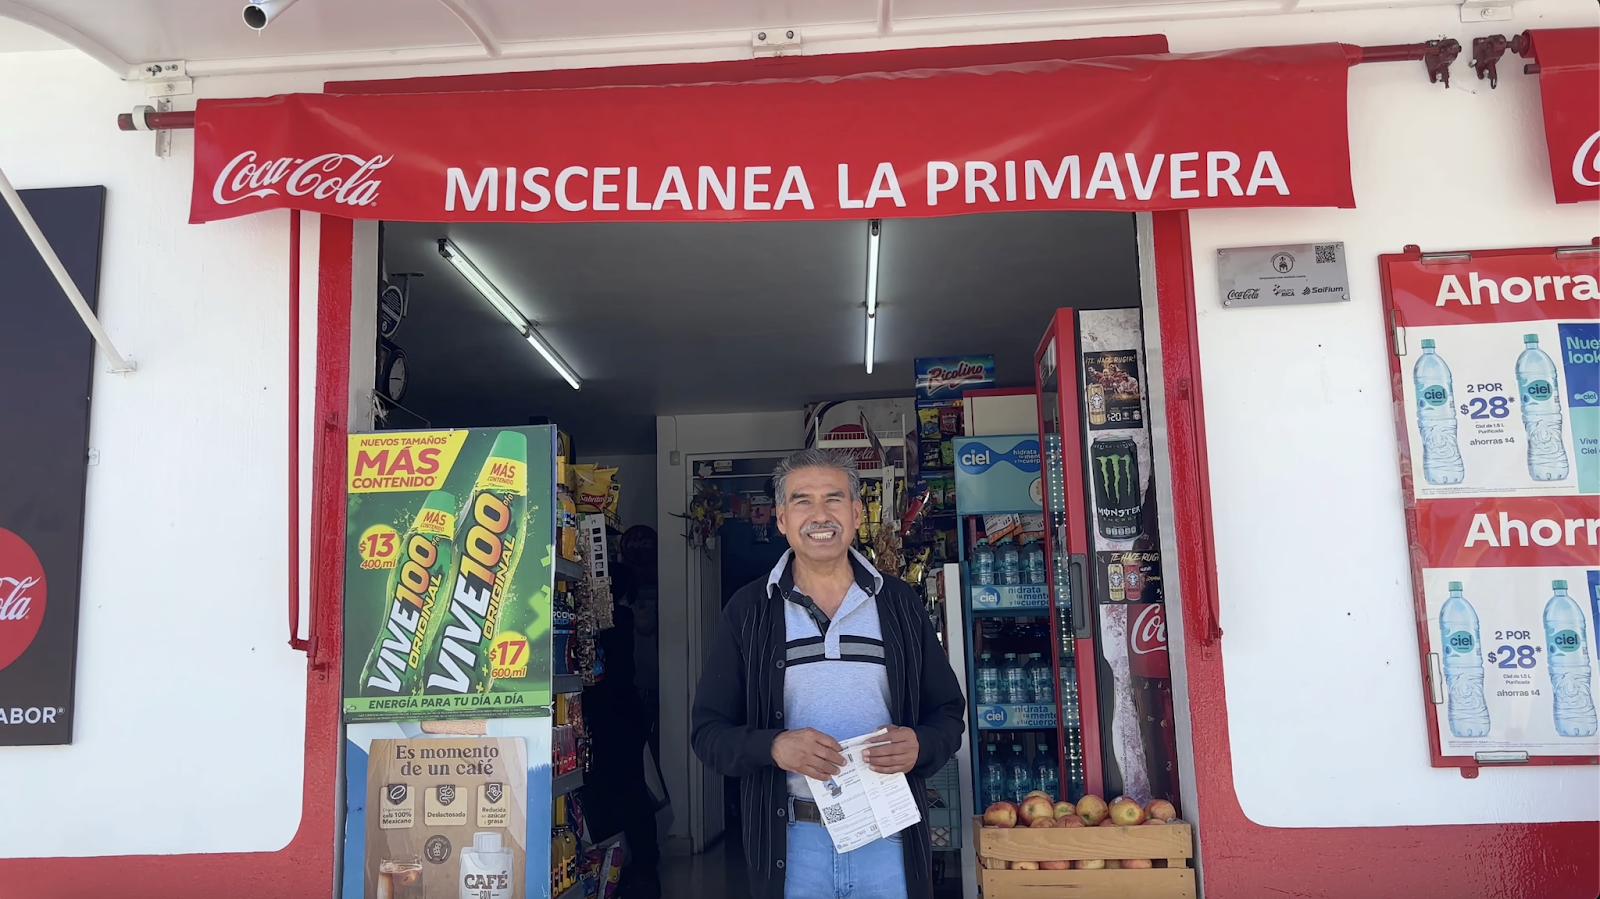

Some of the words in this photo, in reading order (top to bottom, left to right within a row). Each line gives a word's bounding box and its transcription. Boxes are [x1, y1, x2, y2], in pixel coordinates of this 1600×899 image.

[212, 150, 395, 207] Coca-Cola
[444, 165, 814, 212] MISCELANEA
[838, 162, 907, 209] LA
[925, 150, 1291, 206] PRIMAVERA
[1227, 288, 1260, 300] Coca-Cola
[1435, 272, 1600, 307] Ahorra
[1566, 336, 1600, 350] Nue
[928, 362, 984, 395] Ricolino
[1467, 384, 1475, 393] 2
[1477, 383, 1503, 392] POR
[1528, 384, 1551, 396] ciel
[1424, 389, 1447, 401] ciel
[1583, 393, 1597, 401] ciel
[360, 438, 399, 447] NUEVOS
[400, 435, 447, 446] TAMAÑOS
[1579, 438, 1598, 446] Vive
[961, 449, 990, 465] ciel
[1581, 447, 1598, 455] Ciel
[353, 446, 442, 477] MÁS
[489, 462, 516, 479] MÁS
[487, 476, 514, 486] CONTENIDO
[423, 511, 447, 526] MÁS
[420, 522, 445, 532] CONTENIDO
[1110, 553, 1120, 563] TE
[1120, 552, 1142, 562] HACE
[361, 559, 382, 569] 400
[383, 559, 396, 568] ml
[482, 536, 516, 640] ORIGINAL
[979, 592, 998, 602] ciel
[407, 573, 442, 670] ORIGINAL
[1450, 634, 1473, 647] ciel
[1494, 631, 1503, 640] 2
[1506, 631, 1531, 640] POR
[1554, 633, 1579, 646] ciel
[491, 668, 511, 678] 600
[511, 666, 527, 678] ml
[1496, 689, 1529, 697] ahorras
[1530, 689, 1541, 697] $4
[369, 697, 418, 709] ENERGÍA
[421, 697, 451, 707] PARA
[454, 696, 469, 706] TU
[472, 695, 491, 705] DÍA
[493, 695, 501, 704] A
[504, 694, 524, 704] DÍA
[986, 711, 1004, 721] ciel
[396, 745, 415, 760] Es
[420, 744, 499, 759] momento
[400, 762, 422, 776] de
[428, 764, 450, 776] un
[456, 758, 494, 776] café
[464, 870, 508, 889] CAFÉ
[479, 891, 492, 899] CON
